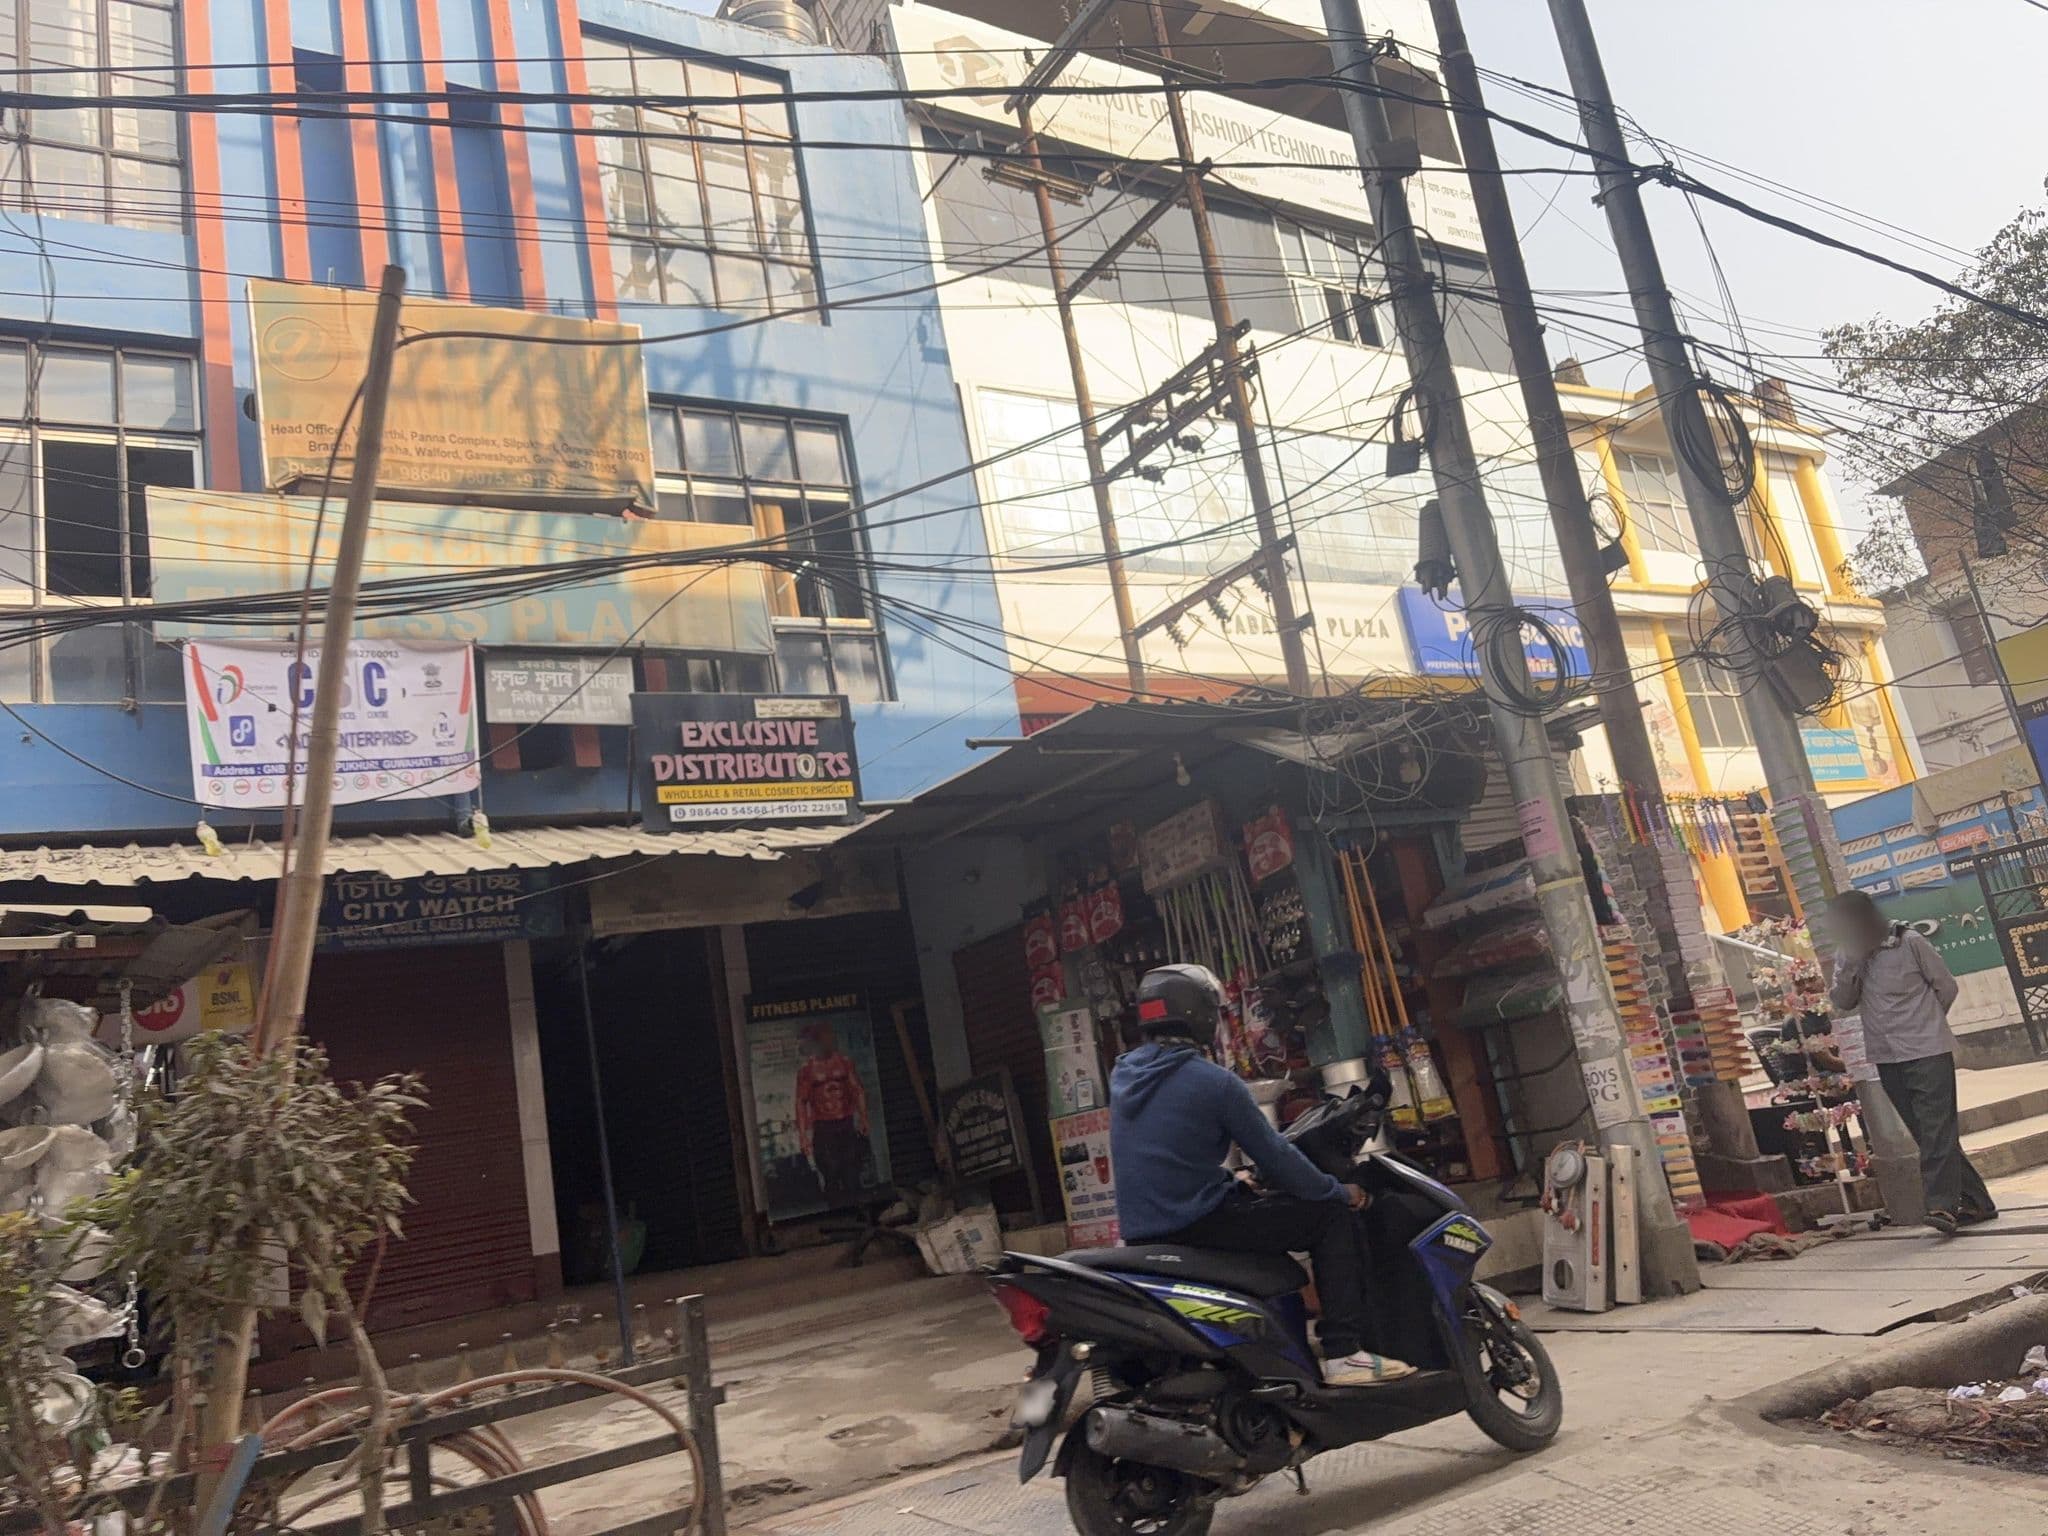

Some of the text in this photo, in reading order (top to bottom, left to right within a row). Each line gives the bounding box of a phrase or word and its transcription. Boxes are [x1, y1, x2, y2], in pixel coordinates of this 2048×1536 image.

[270, 424, 302, 435] Head
[410, 431, 445, 444] Panna
[400, 466, 450, 483] 98640
[1326, 617, 1390, 639] PLAZA
[681, 721, 819, 748] EXCLUSIVE
[214, 764, 255, 776] Address
[382, 756, 433, 769] GUWAHATI
[651, 752, 851, 781] DISTRIBUTORS
[665, 783, 849, 800] WHOLESALE & RETAIL COSMETIC PRODUCT
[689, 807, 728, 818] 98640
[343, 894, 516, 920] CITY WATCH
[429, 918, 464, 932] SALES
[476, 914, 521, 929] SERVICE
[752, 993, 857, 1017] FITNESS PLANET
[1590, 1084, 1620, 1105] PG
